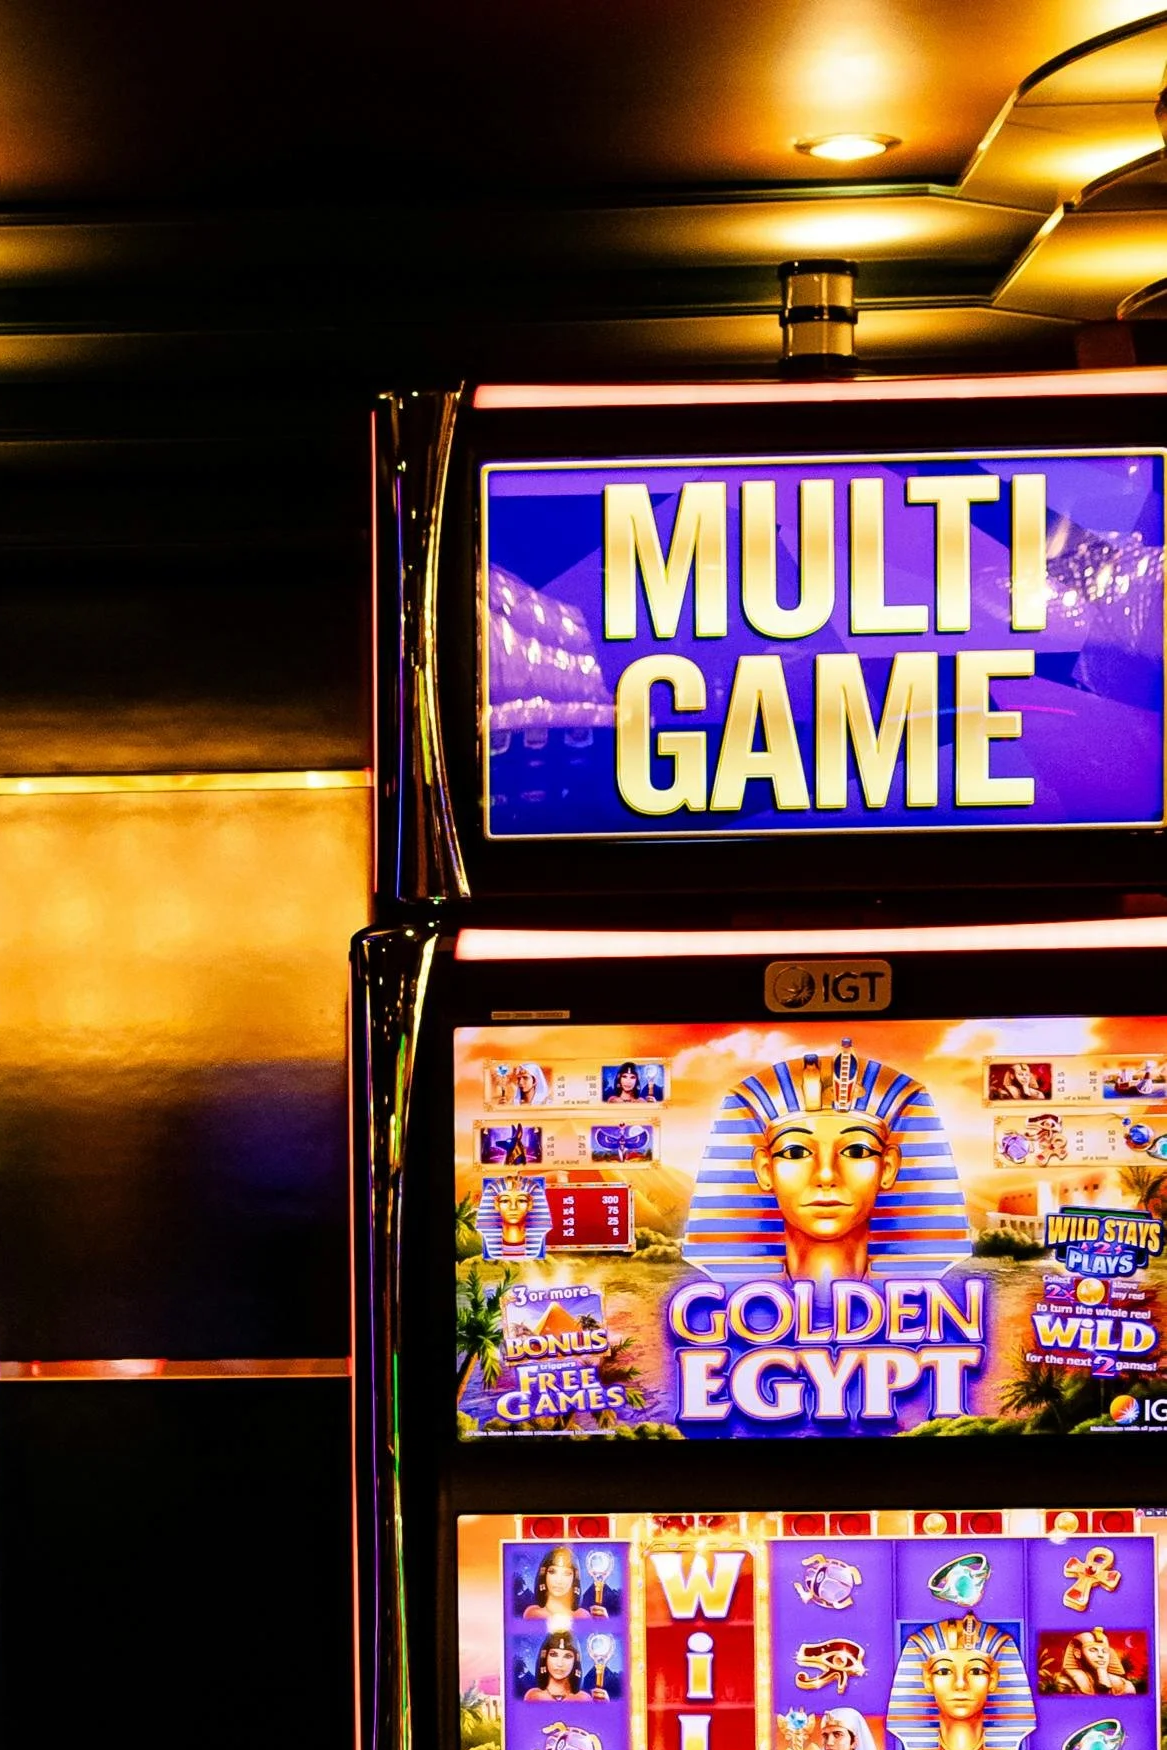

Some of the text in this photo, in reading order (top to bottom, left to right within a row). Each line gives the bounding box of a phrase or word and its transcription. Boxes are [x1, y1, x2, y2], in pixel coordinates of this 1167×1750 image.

[603, 473, 1047, 640] MULTI
[616, 648, 1036, 817] GAME
[822, 972, 884, 1003] IGT
[563, 1196, 619, 1205] x5 300
[563, 1207, 619, 1215] x4 75
[607, 1217, 619, 1225] 25
[563, 1228, 619, 1237] x2 5
[1047, 1216, 1160, 1253] WILD STAYS
[1094, 1241, 1111, 1254] 2
[1068, 1249, 1133, 1274] PLAYS
[1043, 1275, 1070, 1284] Collect
[1113, 1281, 1138, 1289] above
[513, 1287, 589, 1305] 3 or more
[1045, 1284, 1075, 1299] 2x
[1111, 1292, 1145, 1301] any reel
[670, 1280, 984, 1344] GOLDEN
[1037, 1303, 1151, 1319] to turn the whole reel
[506, 1329, 607, 1360] BONUS
[540, 1362, 576, 1371] triggers
[1026, 1353, 1157, 1376] for the next 2 games!
[517, 1366, 601, 1394] FREE
[677, 1347, 982, 1421] EGYPT
[496, 1387, 625, 1420] GAMES
[1145, 1399, 1167, 1421] IG
